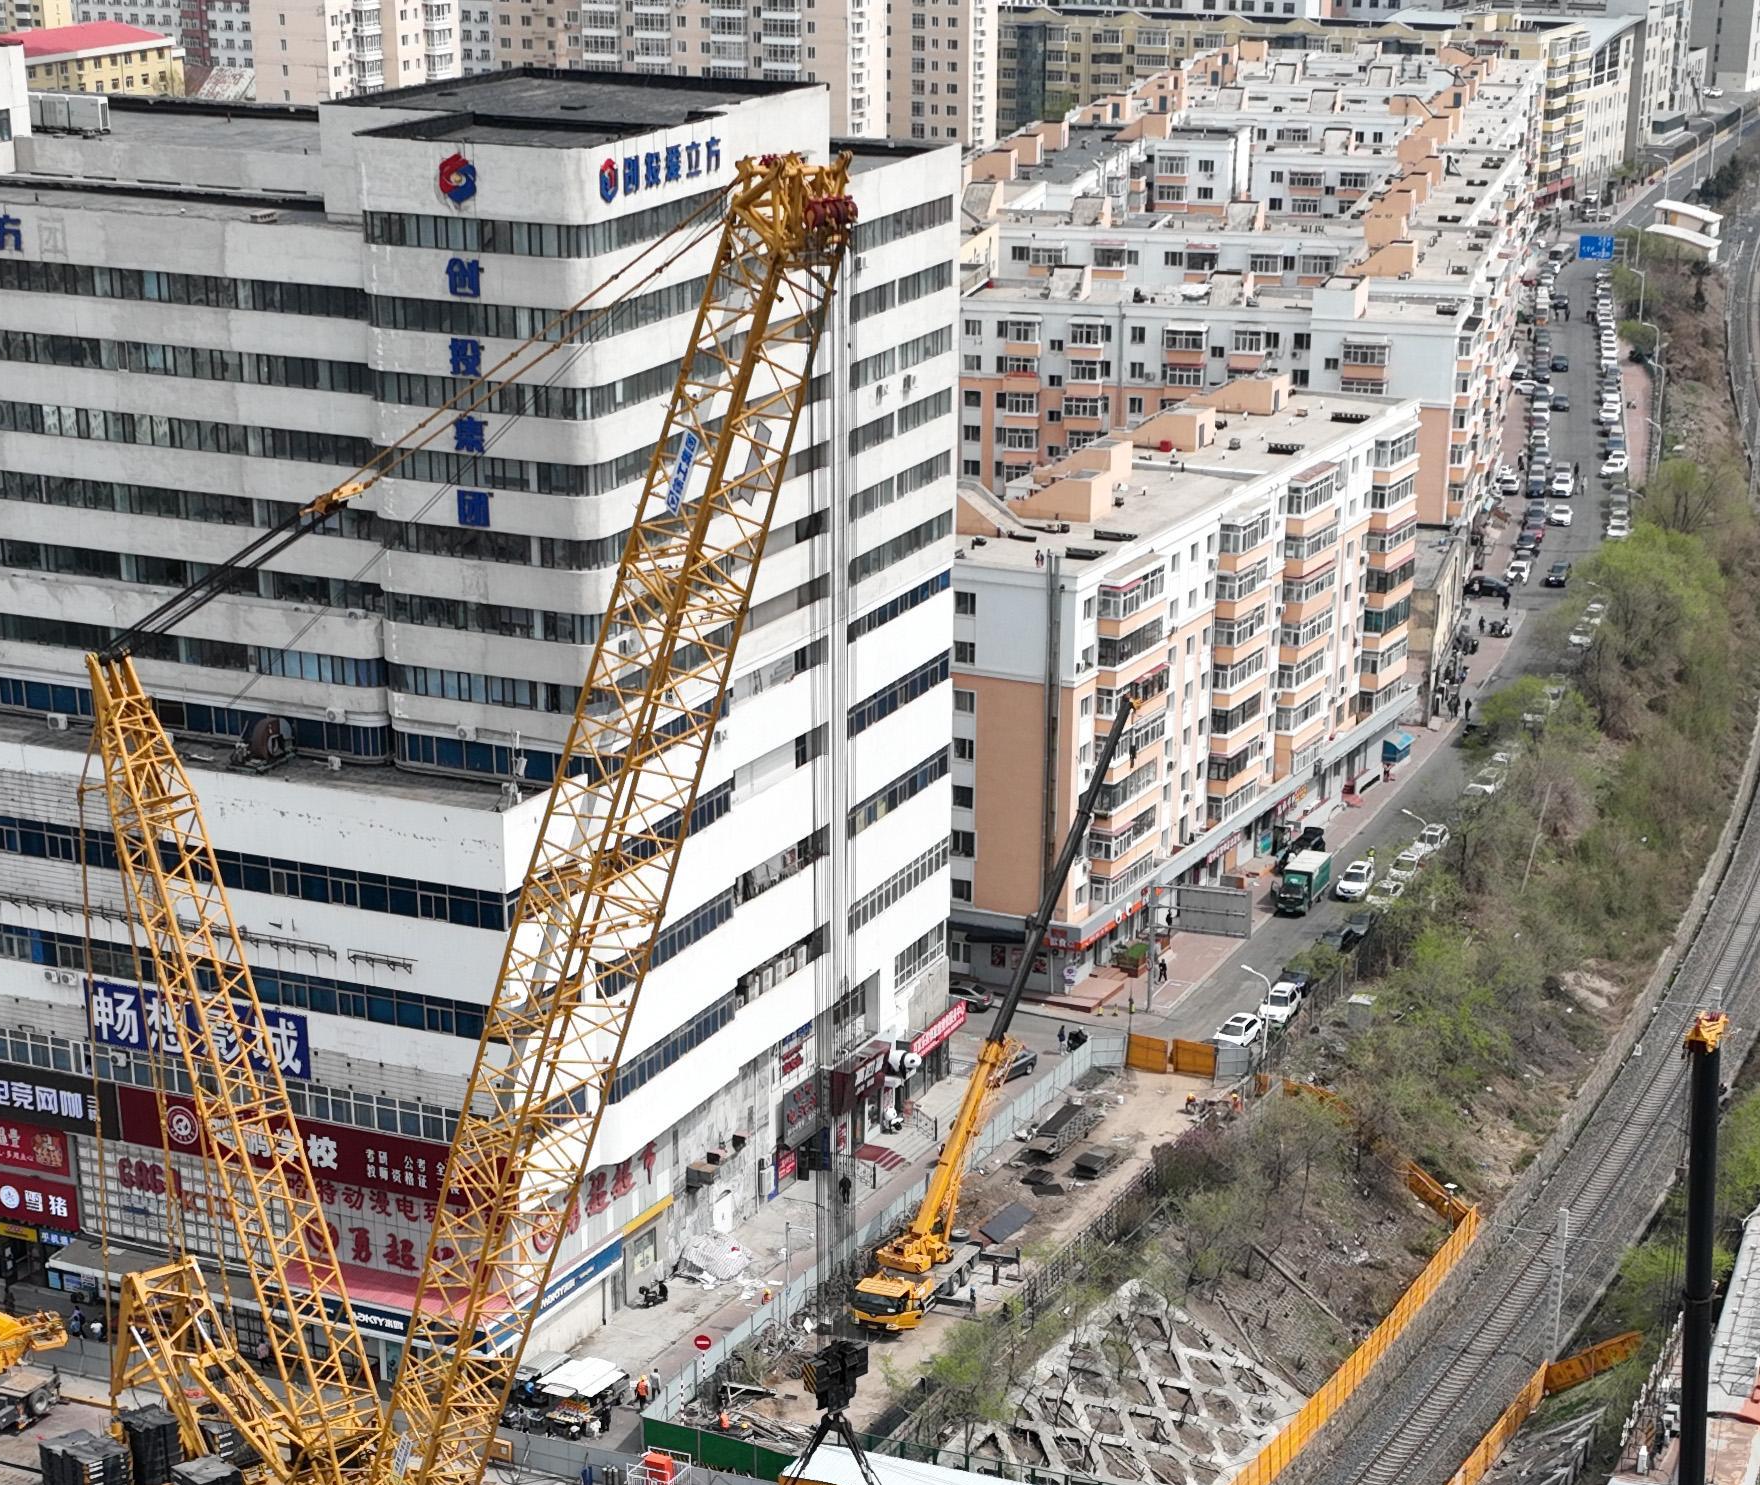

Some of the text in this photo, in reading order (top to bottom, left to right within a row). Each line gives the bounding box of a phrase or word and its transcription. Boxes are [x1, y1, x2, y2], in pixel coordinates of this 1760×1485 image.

[623, 136, 721, 194] 创投爱立方
[446, 257, 491, 527] 创投集团
[93, 986, 303, 1076] 畅想影城
[366, 1163, 428, 1190] 教师资格证
